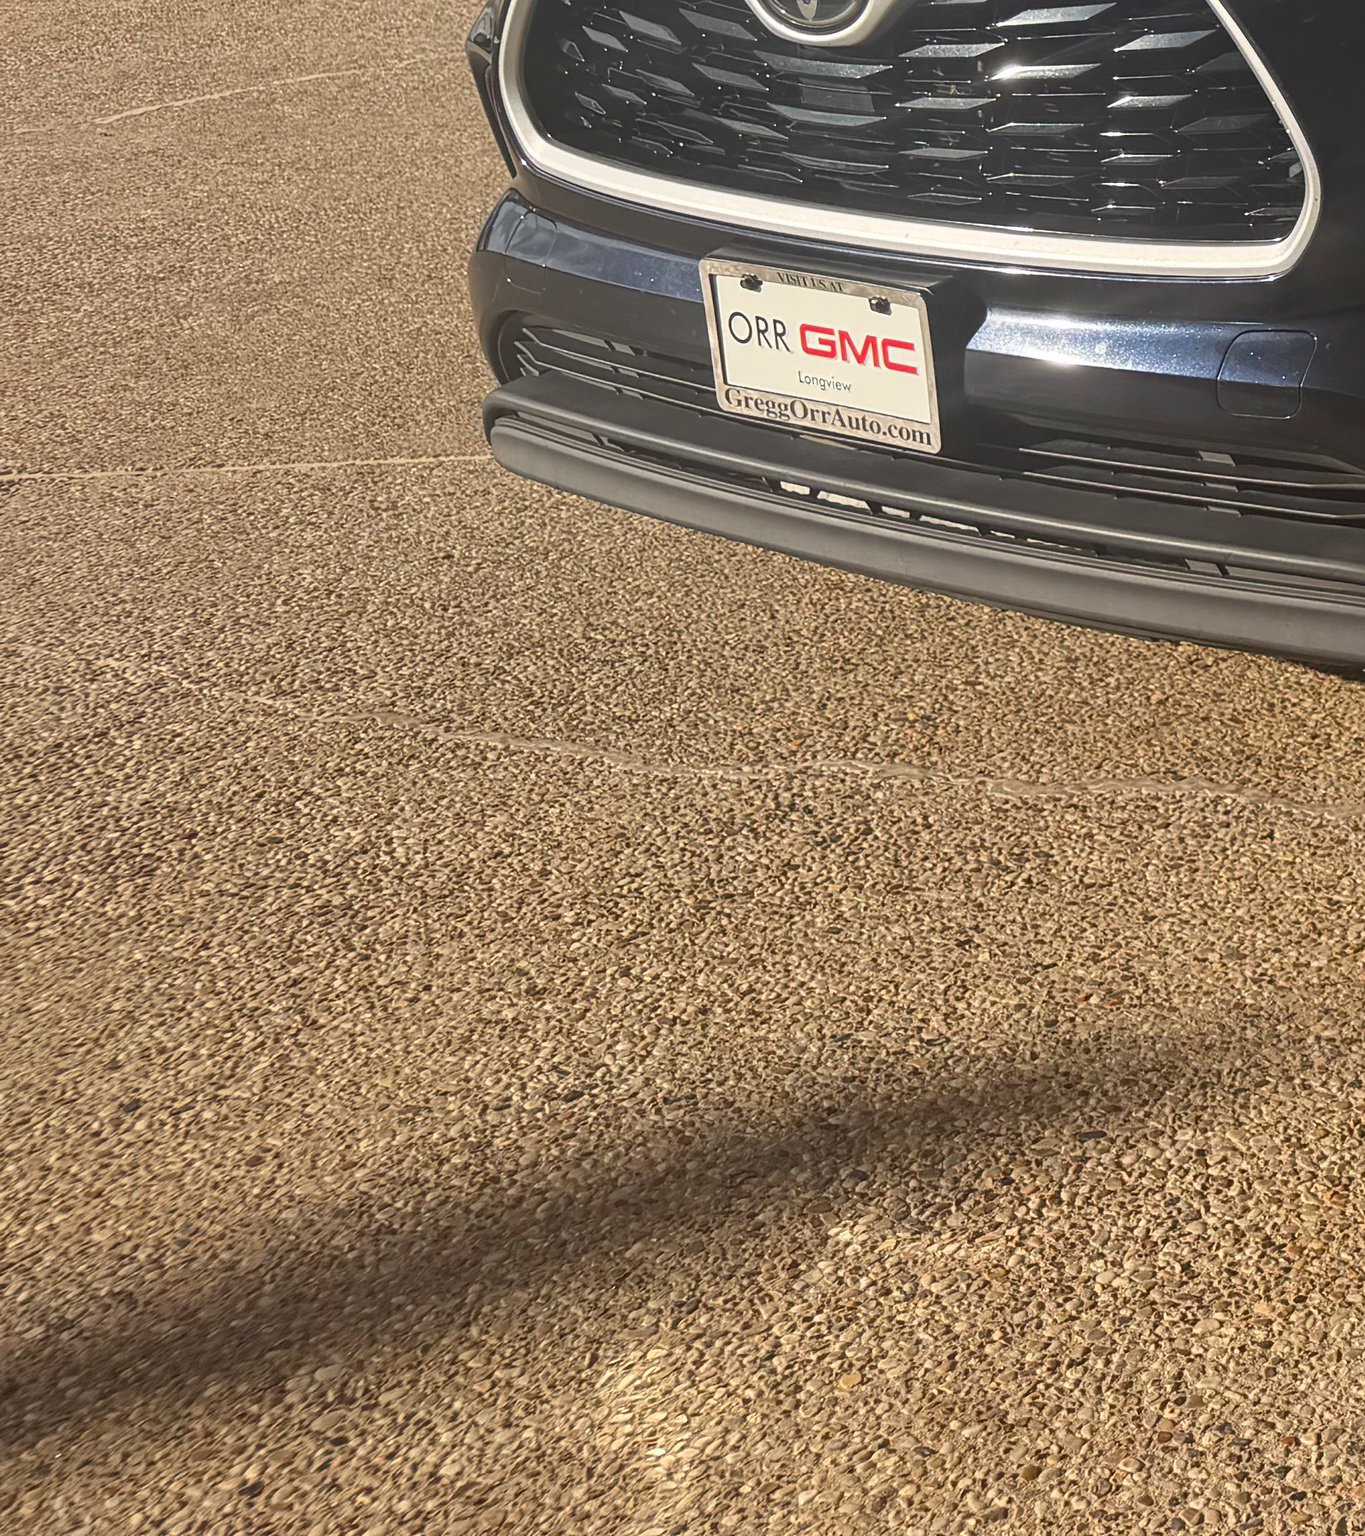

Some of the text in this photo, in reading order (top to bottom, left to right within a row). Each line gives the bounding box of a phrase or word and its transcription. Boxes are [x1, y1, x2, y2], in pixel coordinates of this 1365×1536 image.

[777, 272, 808, 288] VISIT
[830, 280, 846, 293] AT
[728, 311, 920, 375] ORR GMC
[798, 370, 852, 393] Longview
[724, 387, 933, 446] GreggOrrAuto.com
